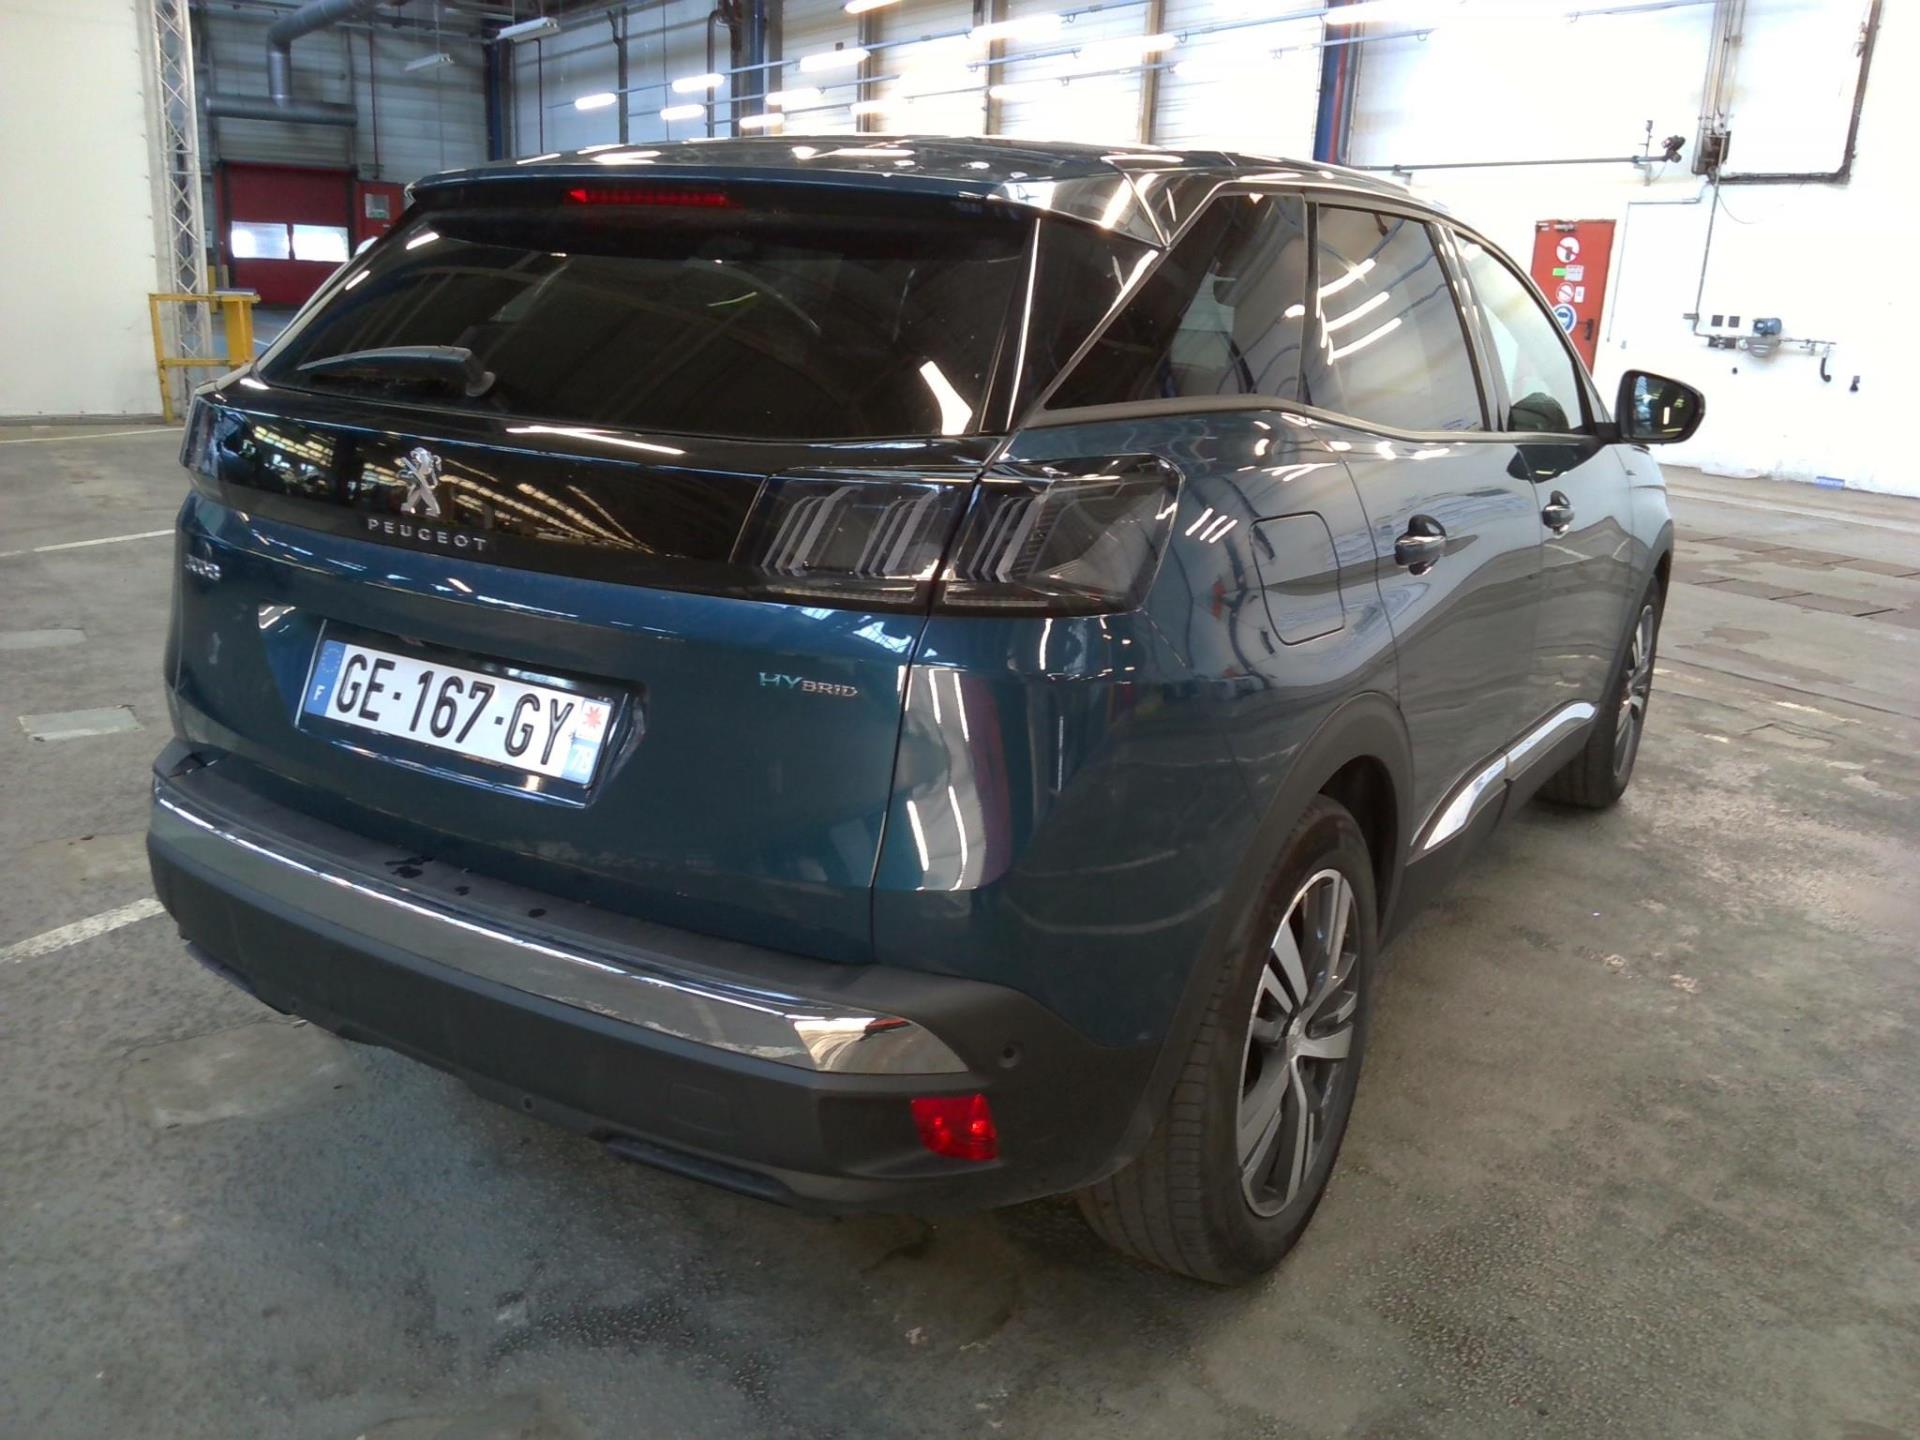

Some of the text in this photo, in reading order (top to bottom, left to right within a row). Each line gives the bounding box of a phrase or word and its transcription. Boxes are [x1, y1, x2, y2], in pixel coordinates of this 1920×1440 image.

[367, 518, 487, 551] PEUGEOT
[313, 684, 326, 701] F
[759, 671, 858, 698] HYBRID
